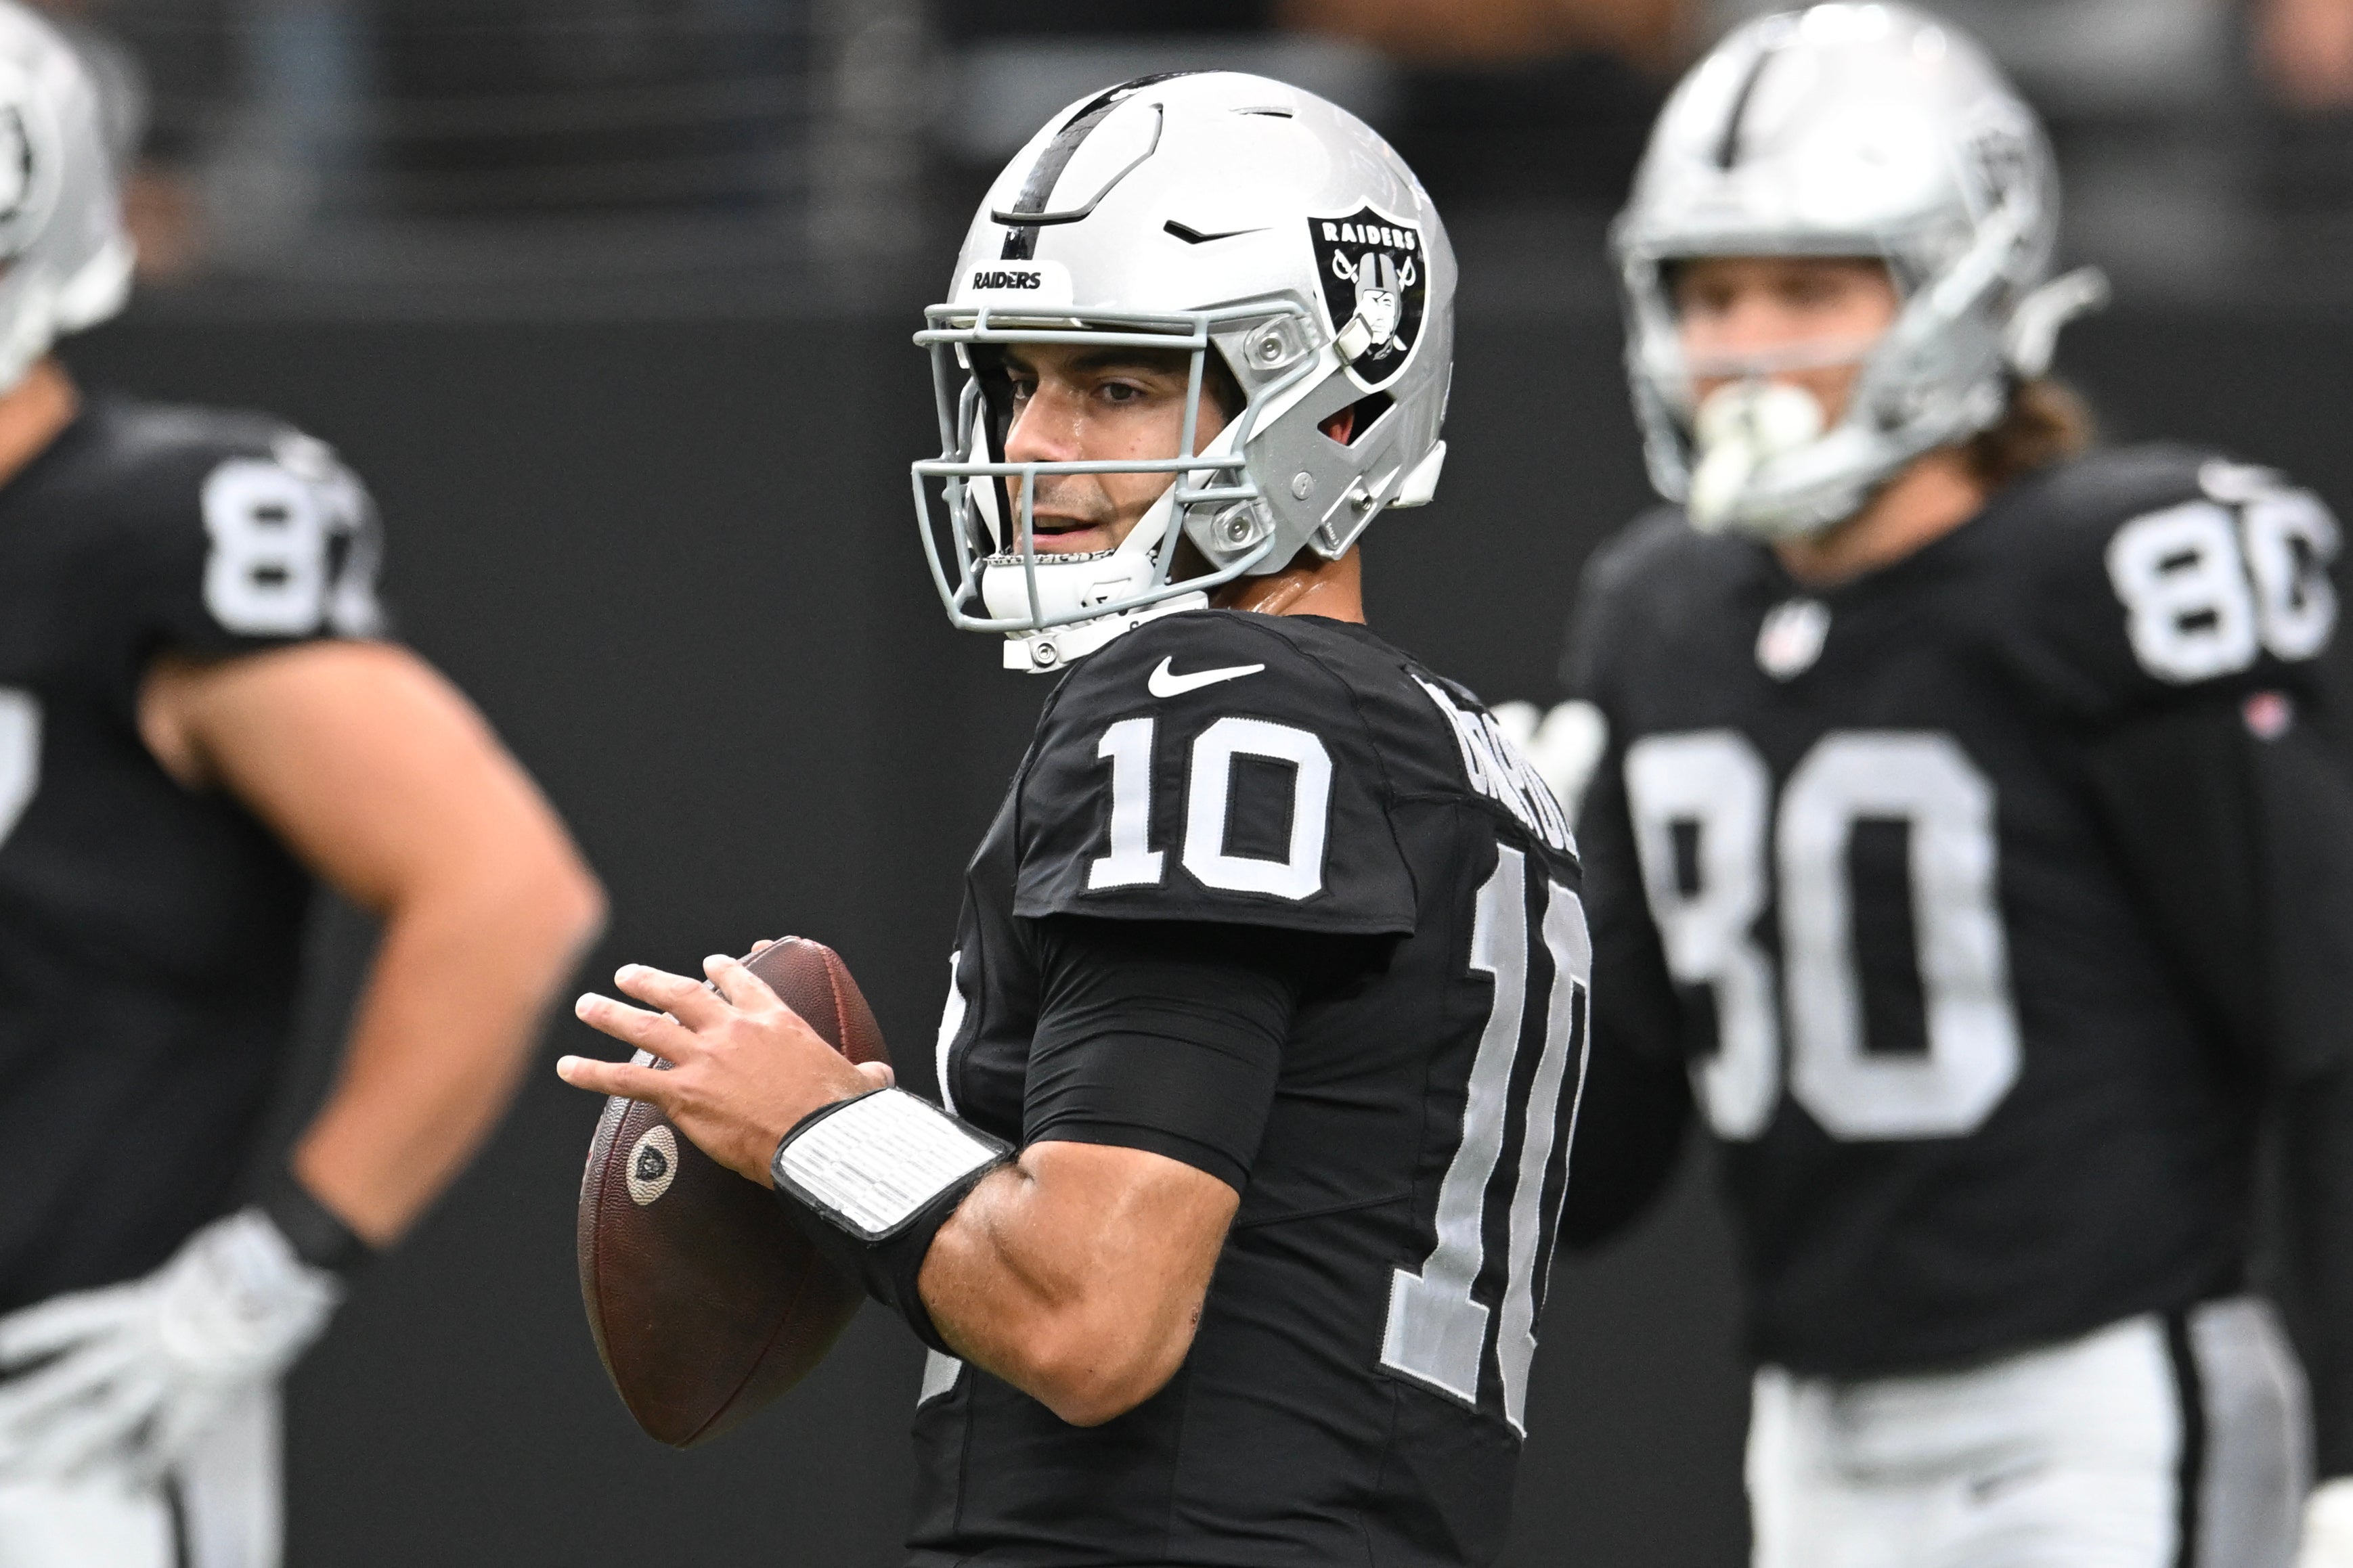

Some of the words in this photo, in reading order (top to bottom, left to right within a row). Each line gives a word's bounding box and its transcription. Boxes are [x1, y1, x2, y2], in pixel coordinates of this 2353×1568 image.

[973, 271, 1041, 290] RAIDERS
[1321, 222, 1415, 250] RAIDERS
[2104, 489, 2342, 682] 80
[1087, 717, 1333, 901] 10
[1623, 729, 2024, 1142] 80
